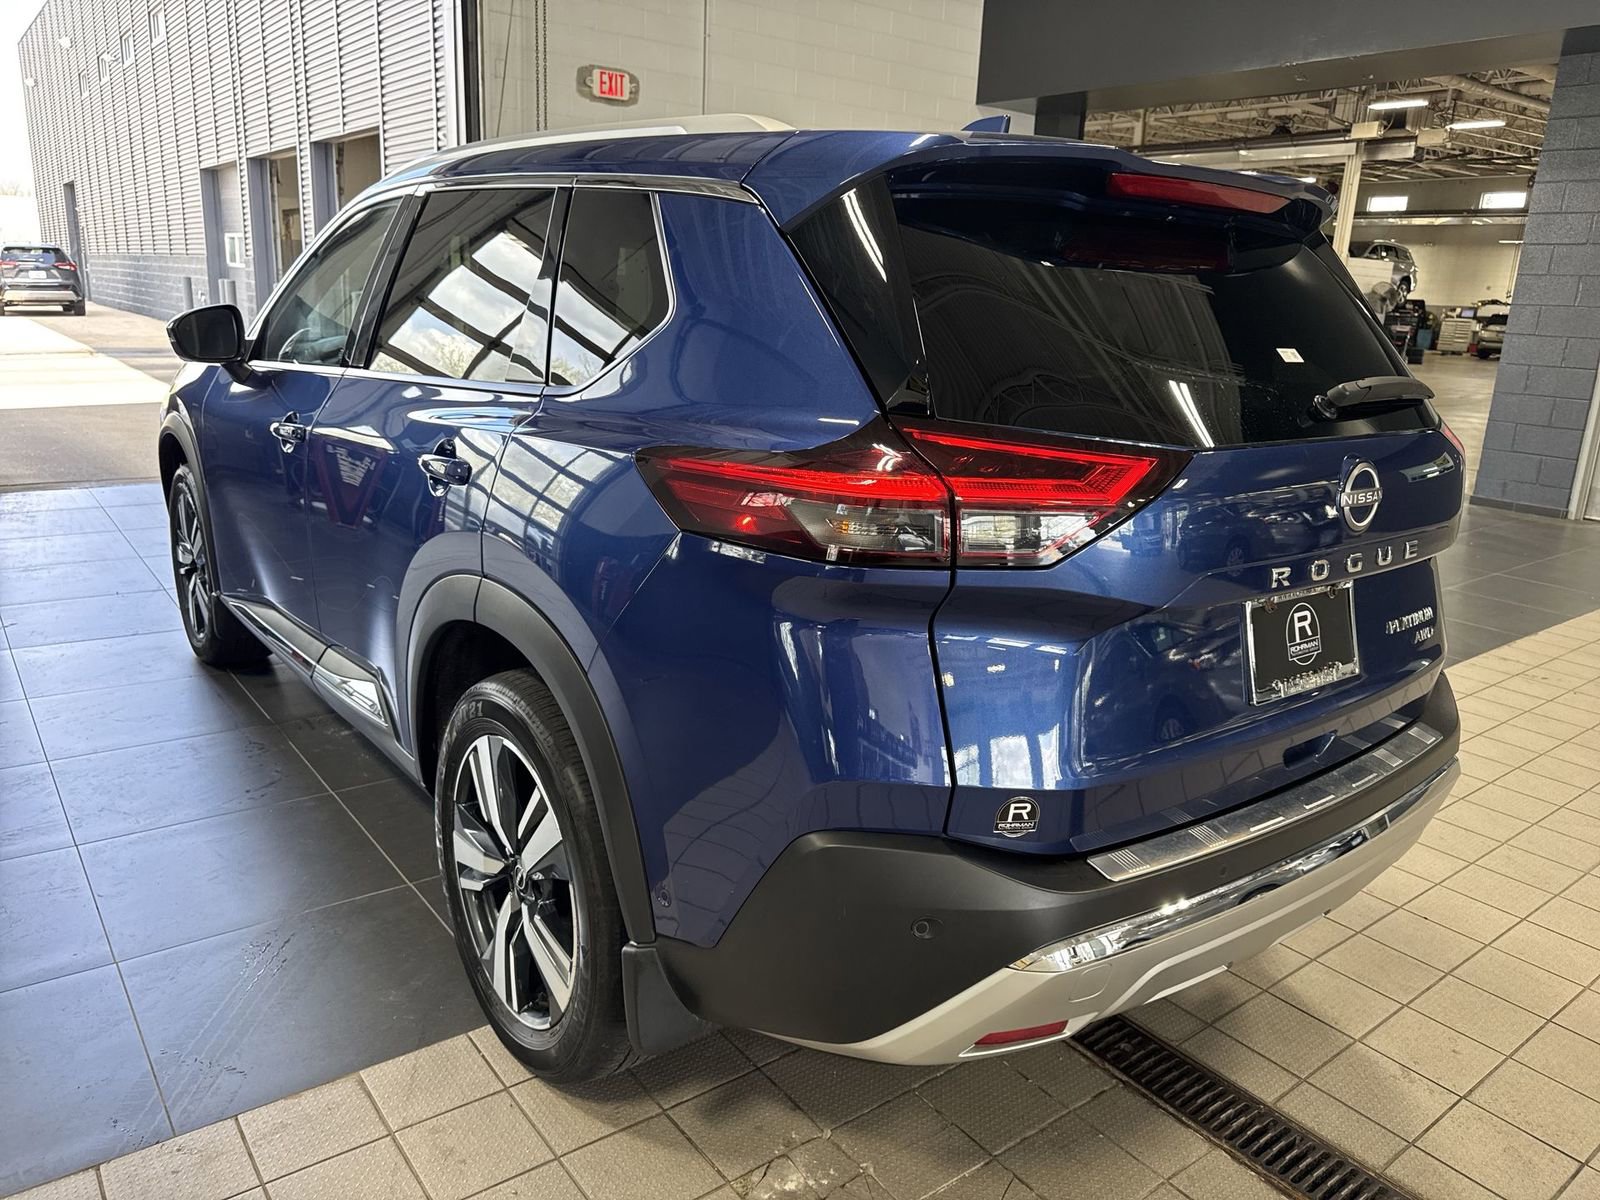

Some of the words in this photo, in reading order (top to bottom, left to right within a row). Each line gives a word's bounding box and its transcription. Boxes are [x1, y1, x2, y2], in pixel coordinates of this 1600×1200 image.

[599, 70, 625, 97] EXIT
[1271, 539, 1419, 588] ROGUE
[1294, 610, 1312, 642] R
[1007, 803, 1032, 822] R
